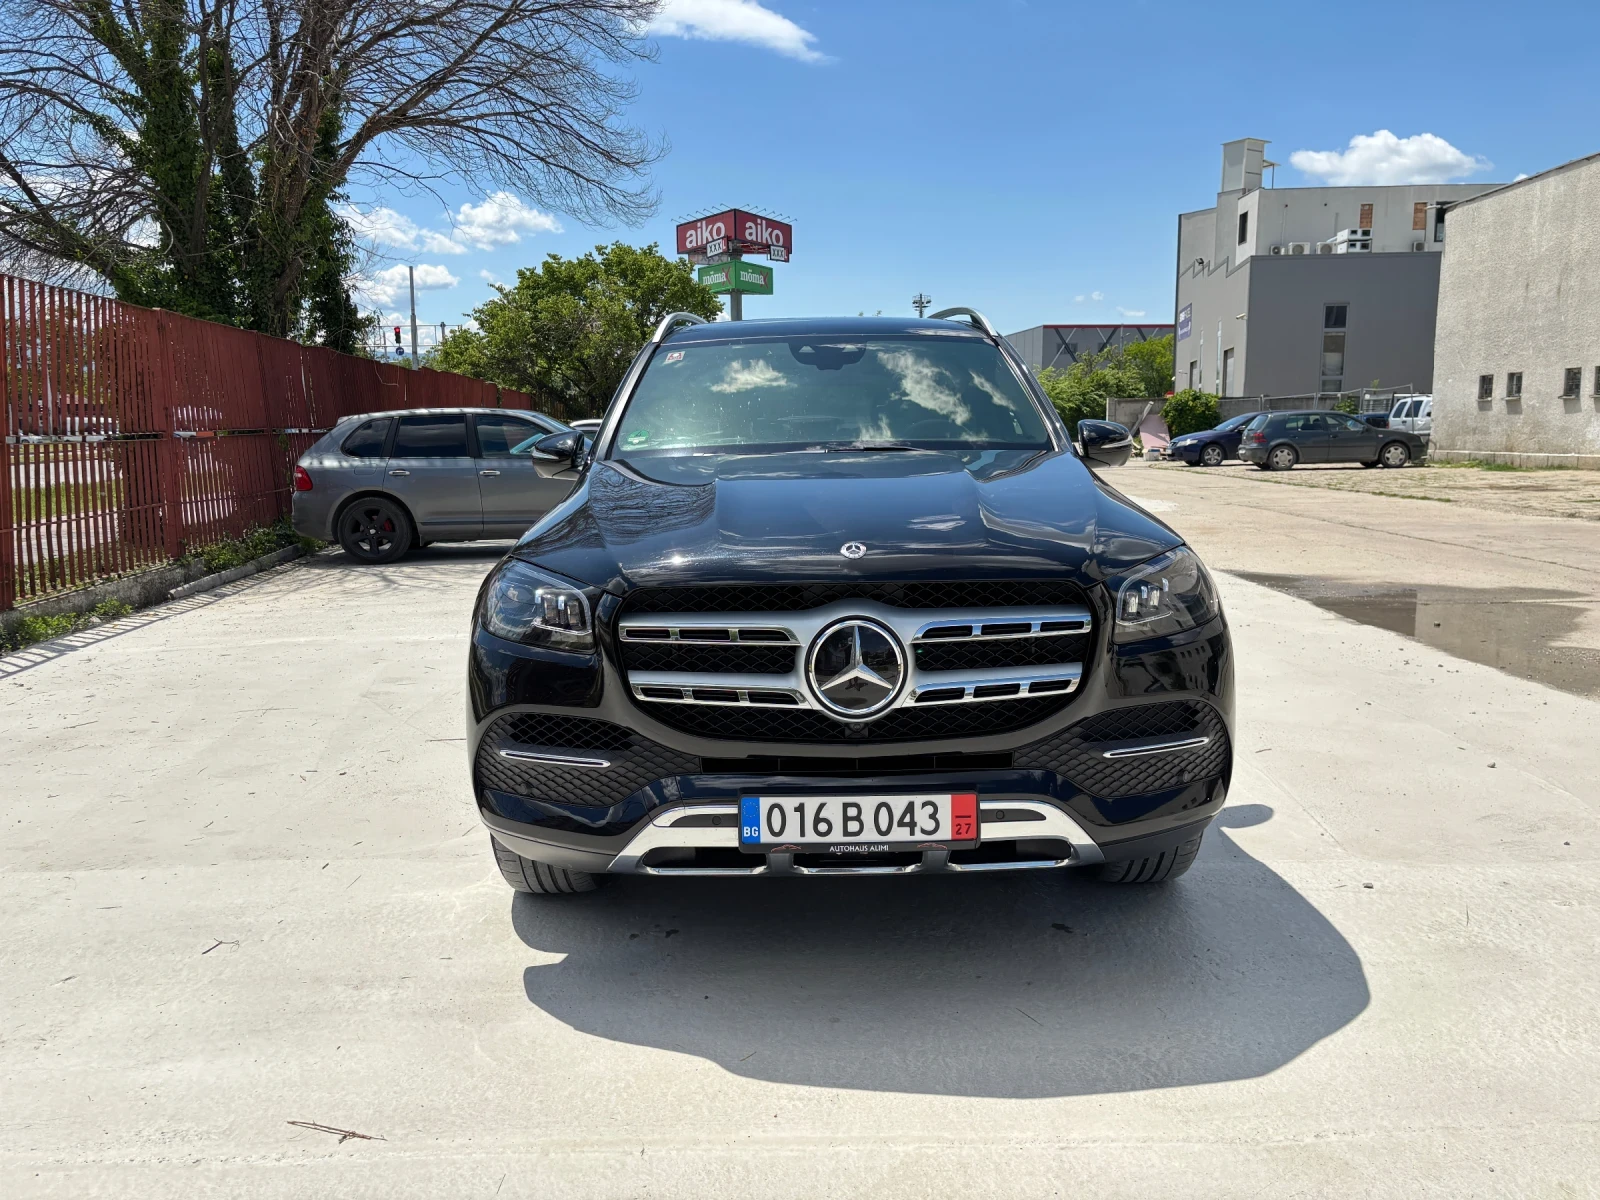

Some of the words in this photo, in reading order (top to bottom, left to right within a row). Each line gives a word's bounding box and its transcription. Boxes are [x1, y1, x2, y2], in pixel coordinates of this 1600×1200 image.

[685, 221, 725, 248] aiko
[745, 219, 784, 246] aiko
[743, 826, 759, 837] BG
[955, 823, 972, 836] 27
[869, 844, 889, 852] ALIMI
